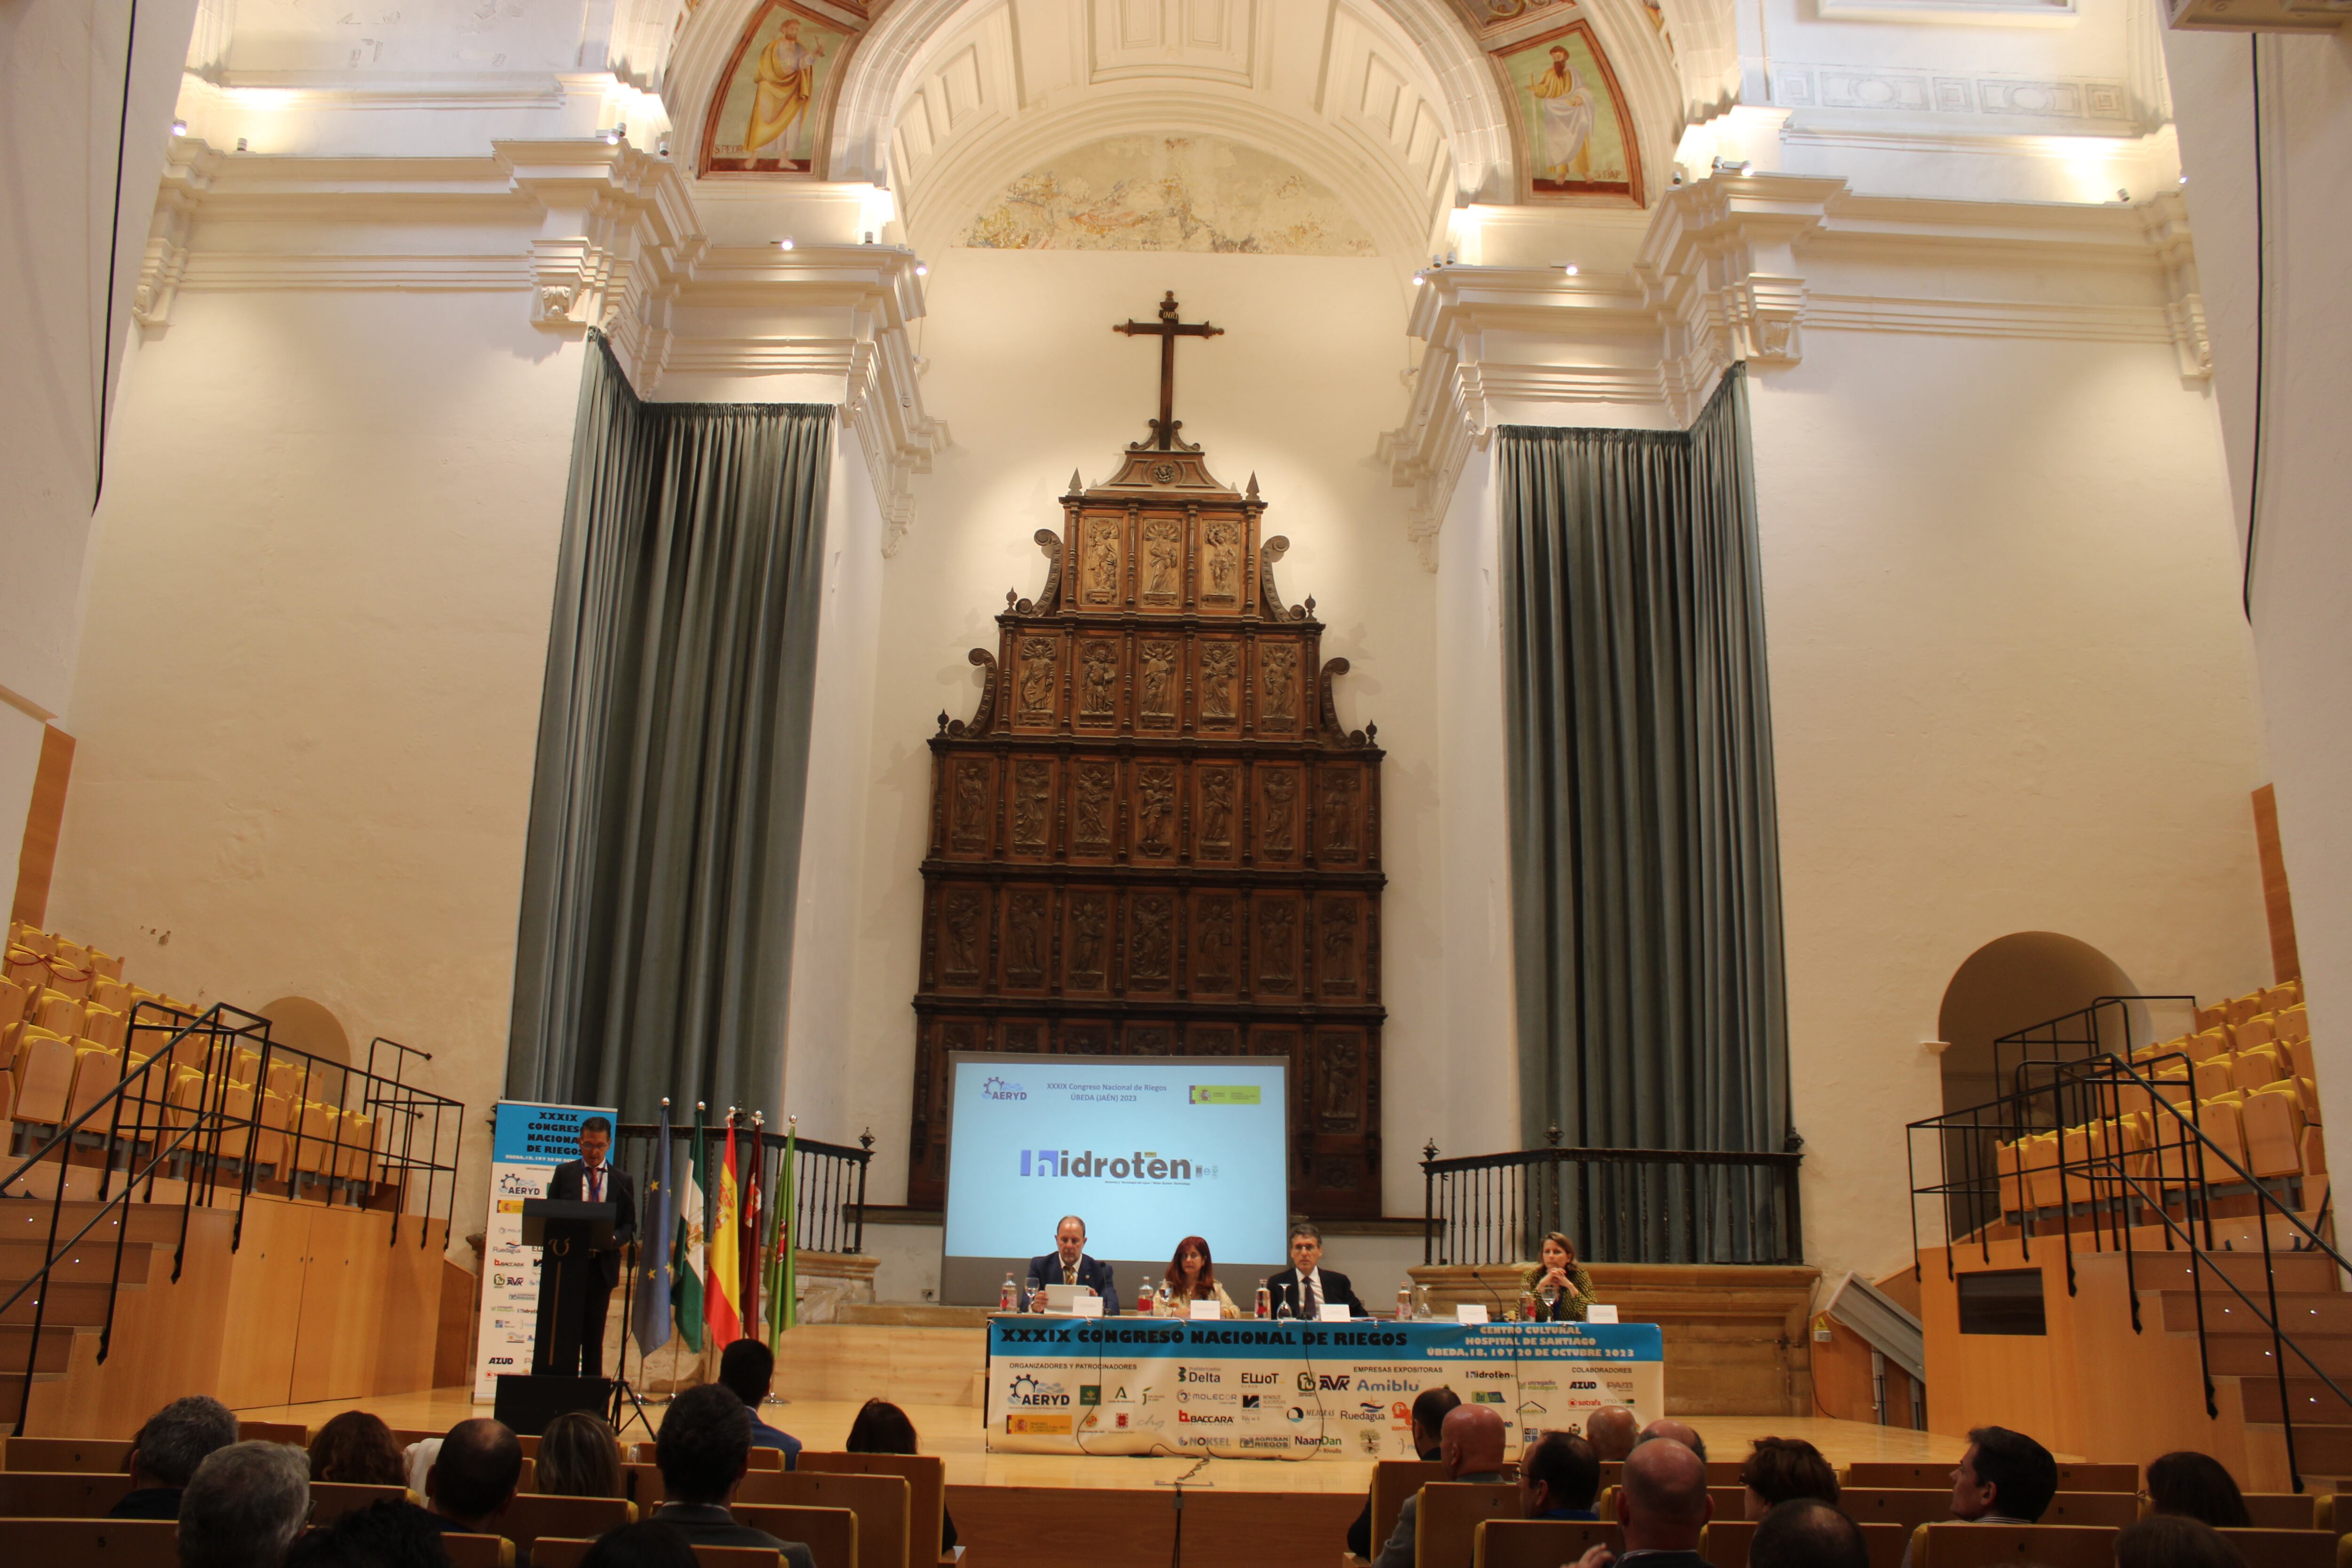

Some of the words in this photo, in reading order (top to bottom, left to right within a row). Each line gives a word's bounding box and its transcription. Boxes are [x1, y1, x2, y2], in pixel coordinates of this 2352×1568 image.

[1163, 311, 1178, 319] INRI
[992, 1091, 1027, 1100] AERYD
[1096, 1094, 1118, 1102] (JAÉN)
[540, 1112, 578, 1122] XXXIX
[528, 1122, 582, 1133] CONGRES
[527, 1134, 580, 1144] NACIONA
[508, 1186, 540, 1195] AERYD
[507, 1277, 524, 1286] AVK
[1001, 1329, 1071, 1343] XXXIX
[1078, 1330, 1184, 1344] CONGRESO
[1191, 1331, 1296, 1345] NACIONAL
[1303, 1332, 1327, 1345] DE
[1334, 1332, 1407, 1346] RIEGOS
[1465, 1337, 1520, 1345] HOSPITAL
[1552, 1348, 1602, 1357] OCTUBRE
[1605, 1349, 1634, 1357] 2023
[1189, 1372, 1221, 1383] Delta
[1319, 1375, 1350, 1391] AVK
[1357, 1379, 1419, 1392] Amiblu
[1022, 1394, 1070, 1406] AERYD
[1341, 1410, 1385, 1422] Ruedagua
[1189, 1437, 1231, 1446] NOKSEL
[1295, 1435, 1342, 1445] NaanDan
[86, 1487, 92, 1495] 7
[748, 1519, 753, 1528] 1
[1582, 1531, 1589, 1540] 2
[98, 1536, 106, 1548] 5
